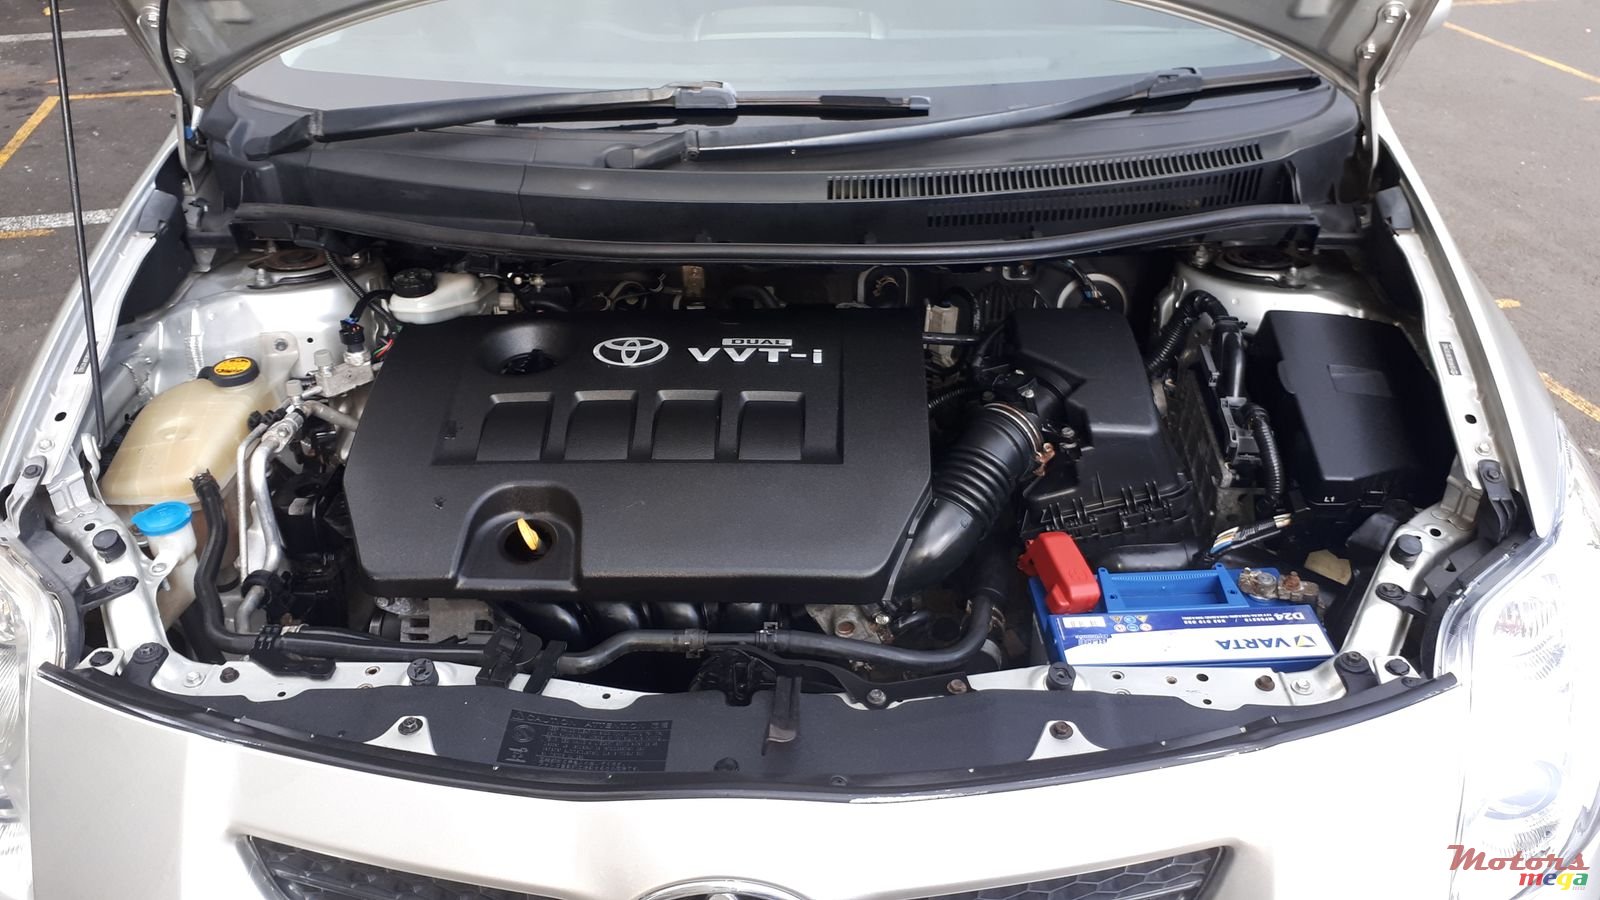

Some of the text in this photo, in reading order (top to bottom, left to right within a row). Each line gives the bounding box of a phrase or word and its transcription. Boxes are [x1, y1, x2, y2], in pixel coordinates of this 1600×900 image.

[687, 347, 823, 364] VVT-i
[1273, 612, 1306, 621] D24
[1214, 637, 1292, 650] VARTA
